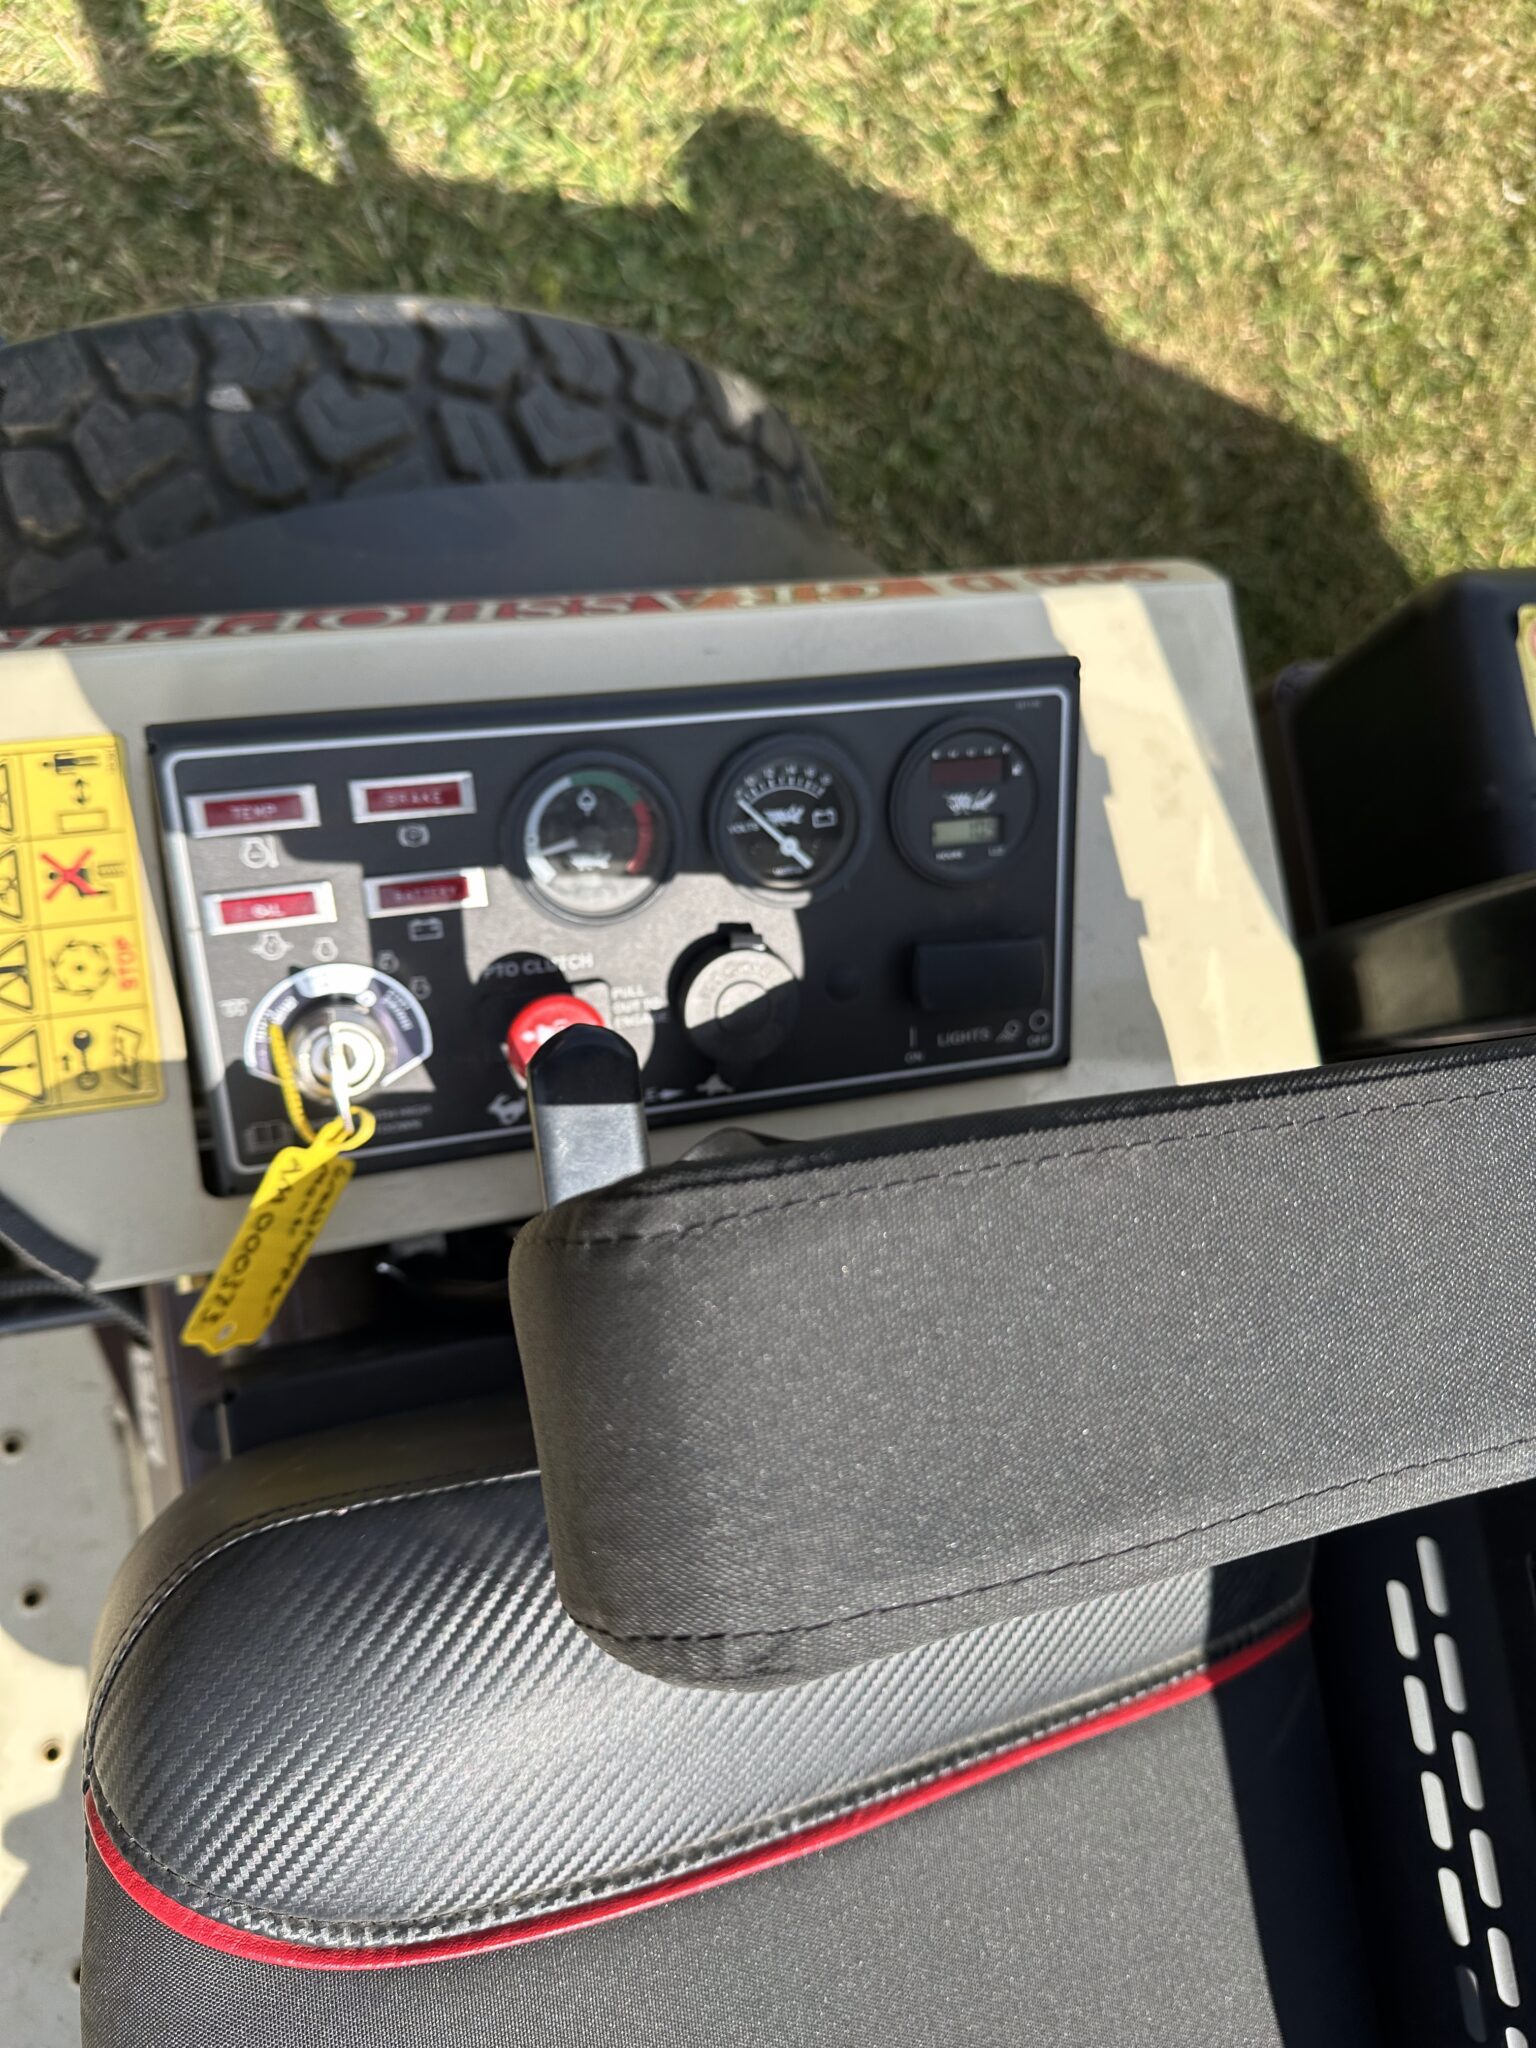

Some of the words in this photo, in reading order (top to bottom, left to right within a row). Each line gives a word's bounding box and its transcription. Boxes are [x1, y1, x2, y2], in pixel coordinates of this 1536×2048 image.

[229, 803, 278, 820] TEMP
[251, 903, 285, 920] OIL
[114, 936, 139, 991] STOP
[483, 961, 520, 979] PTO
[522, 952, 595, 976] CLUTCH
[611, 985, 647, 1000] PULL
[936, 1026, 991, 1048] LIGHTS
[904, 1051, 925, 1064] ON
